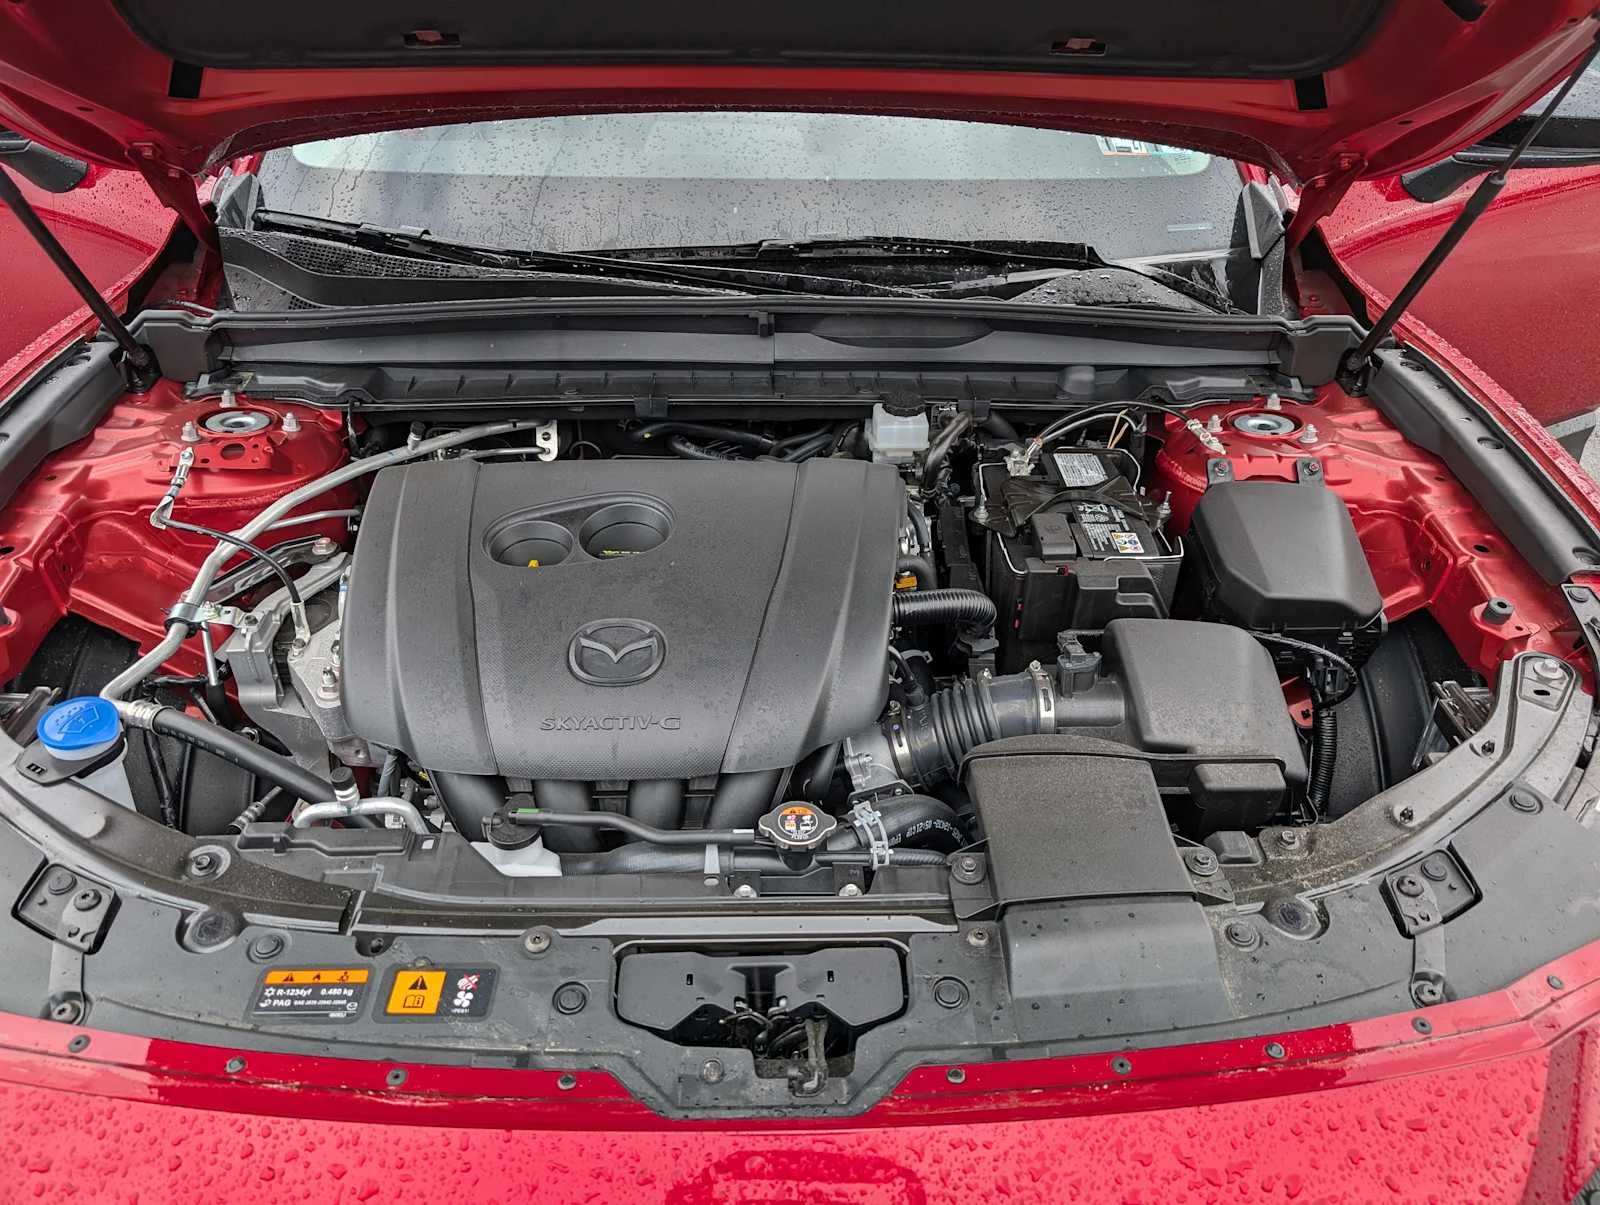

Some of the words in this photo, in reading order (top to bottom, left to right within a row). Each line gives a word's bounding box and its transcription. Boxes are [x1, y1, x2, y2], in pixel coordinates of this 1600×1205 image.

[540, 715, 682, 732] SKYACTIV-G
[276, 987, 313, 997] R-1234yf
[342, 987, 354, 997] kg
[272, 999, 292, 1007] PAG
